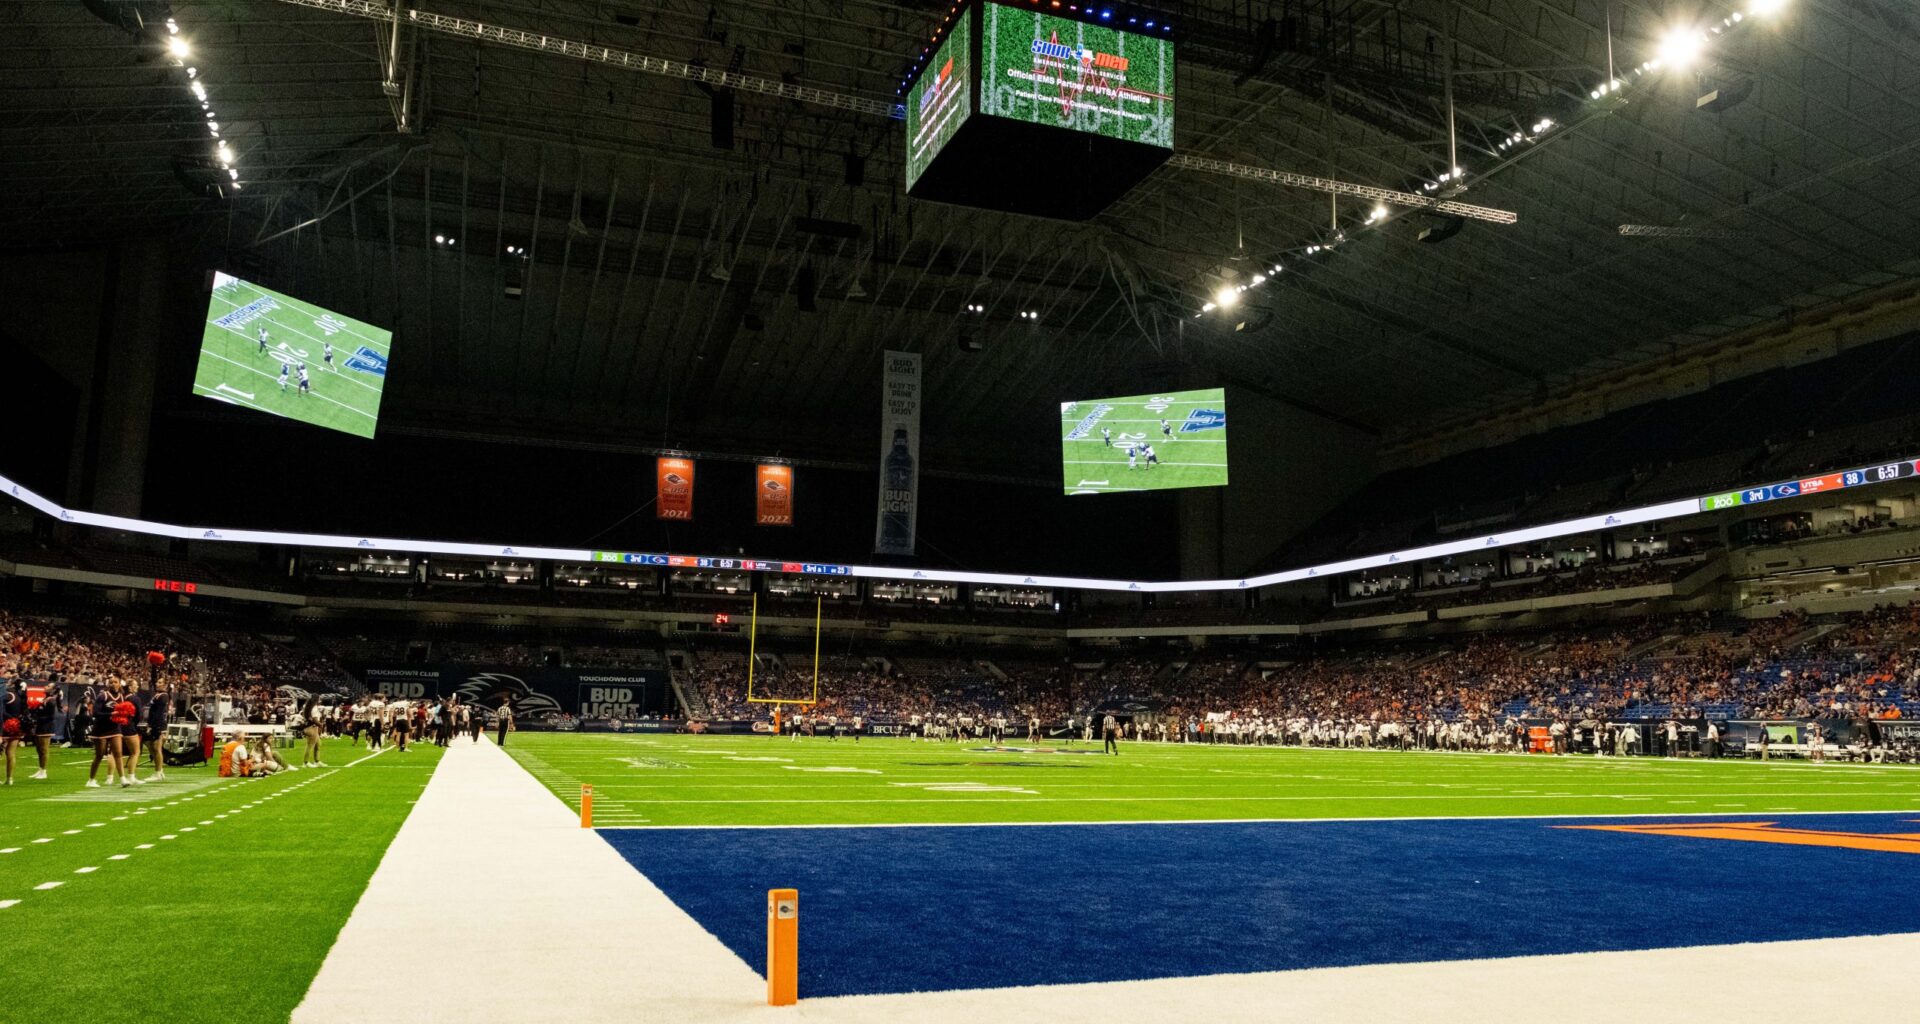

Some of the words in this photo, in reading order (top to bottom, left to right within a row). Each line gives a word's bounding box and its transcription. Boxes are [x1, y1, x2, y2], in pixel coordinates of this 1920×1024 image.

[1100, 70, 1126, 82] SERVICES
[1007, 68, 1035, 80] Official
[1038, 74, 1055, 85] EMS
[1056, 78, 1084, 90] Partner
[1095, 86, 1116, 98] UTSA
[1118, 91, 1150, 104] Athletics
[1016, 90, 1037, 100] Patient
[1038, 94, 1052, 102] Care
[1100, 106, 1120, 116] Service
[1878, 464, 1899, 480] 6:57
[1802, 480, 1824, 488] UTSA
[1846, 472, 1858, 485] 38
[886, 490, 912, 502] BUD
[1749, 490, 1764, 502] 3rd
[662, 510, 688, 518] 2021
[761, 515, 789, 524] 2022
[720, 560, 734, 568] 6:57
[716, 614, 728, 624] 24
[378, 682, 424, 698] BUD
[590, 688, 632, 703] BUD
[581, 702, 640, 720] LIGHT
